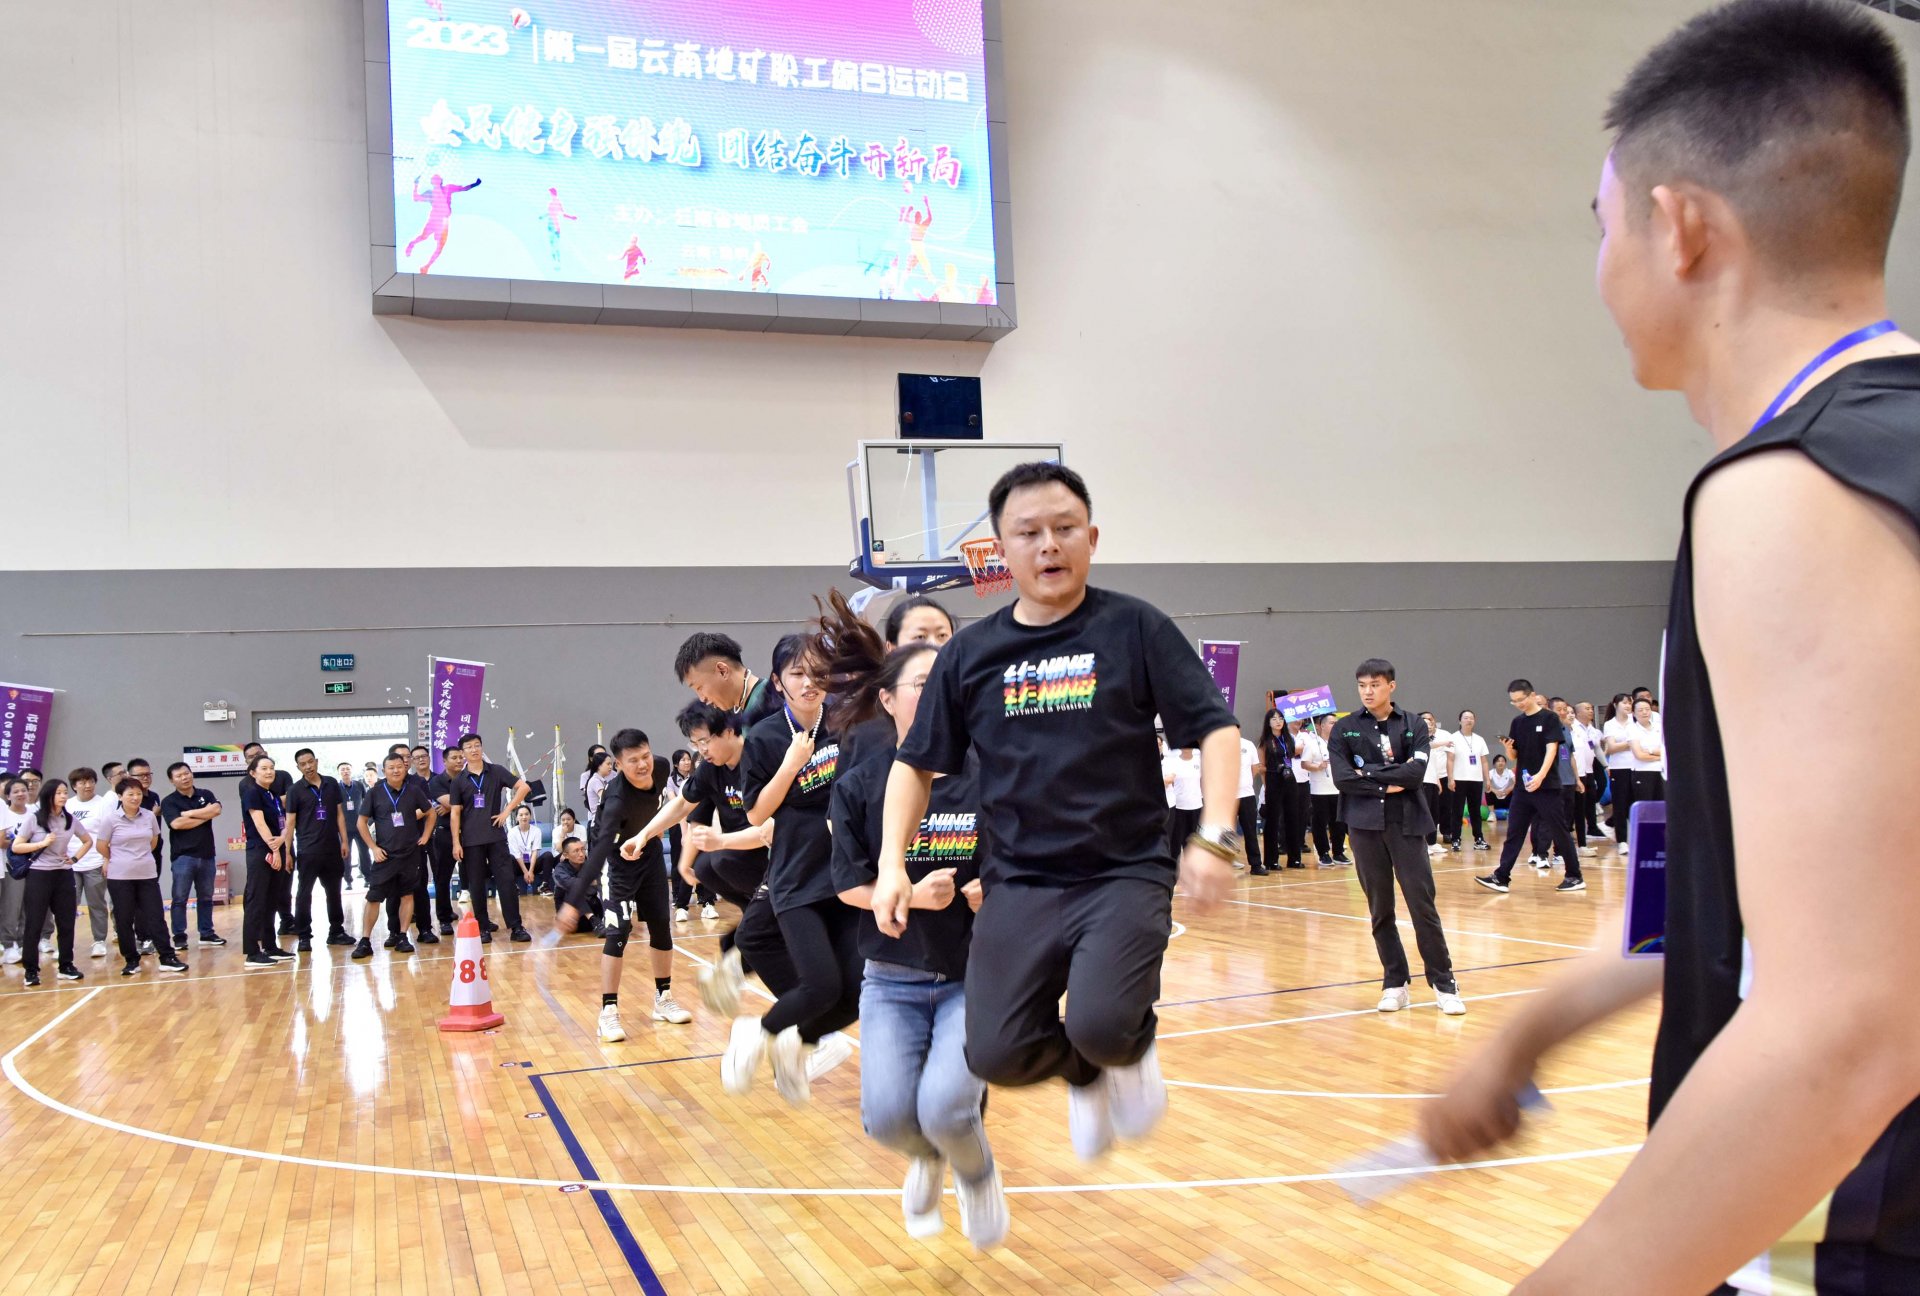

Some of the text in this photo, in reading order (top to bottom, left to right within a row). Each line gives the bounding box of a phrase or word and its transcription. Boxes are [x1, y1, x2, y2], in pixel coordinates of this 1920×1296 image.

[406, 17, 510, 56] 2023
[322, 658, 354, 667] 东门出口2
[920, 813, 977, 831] -NING
